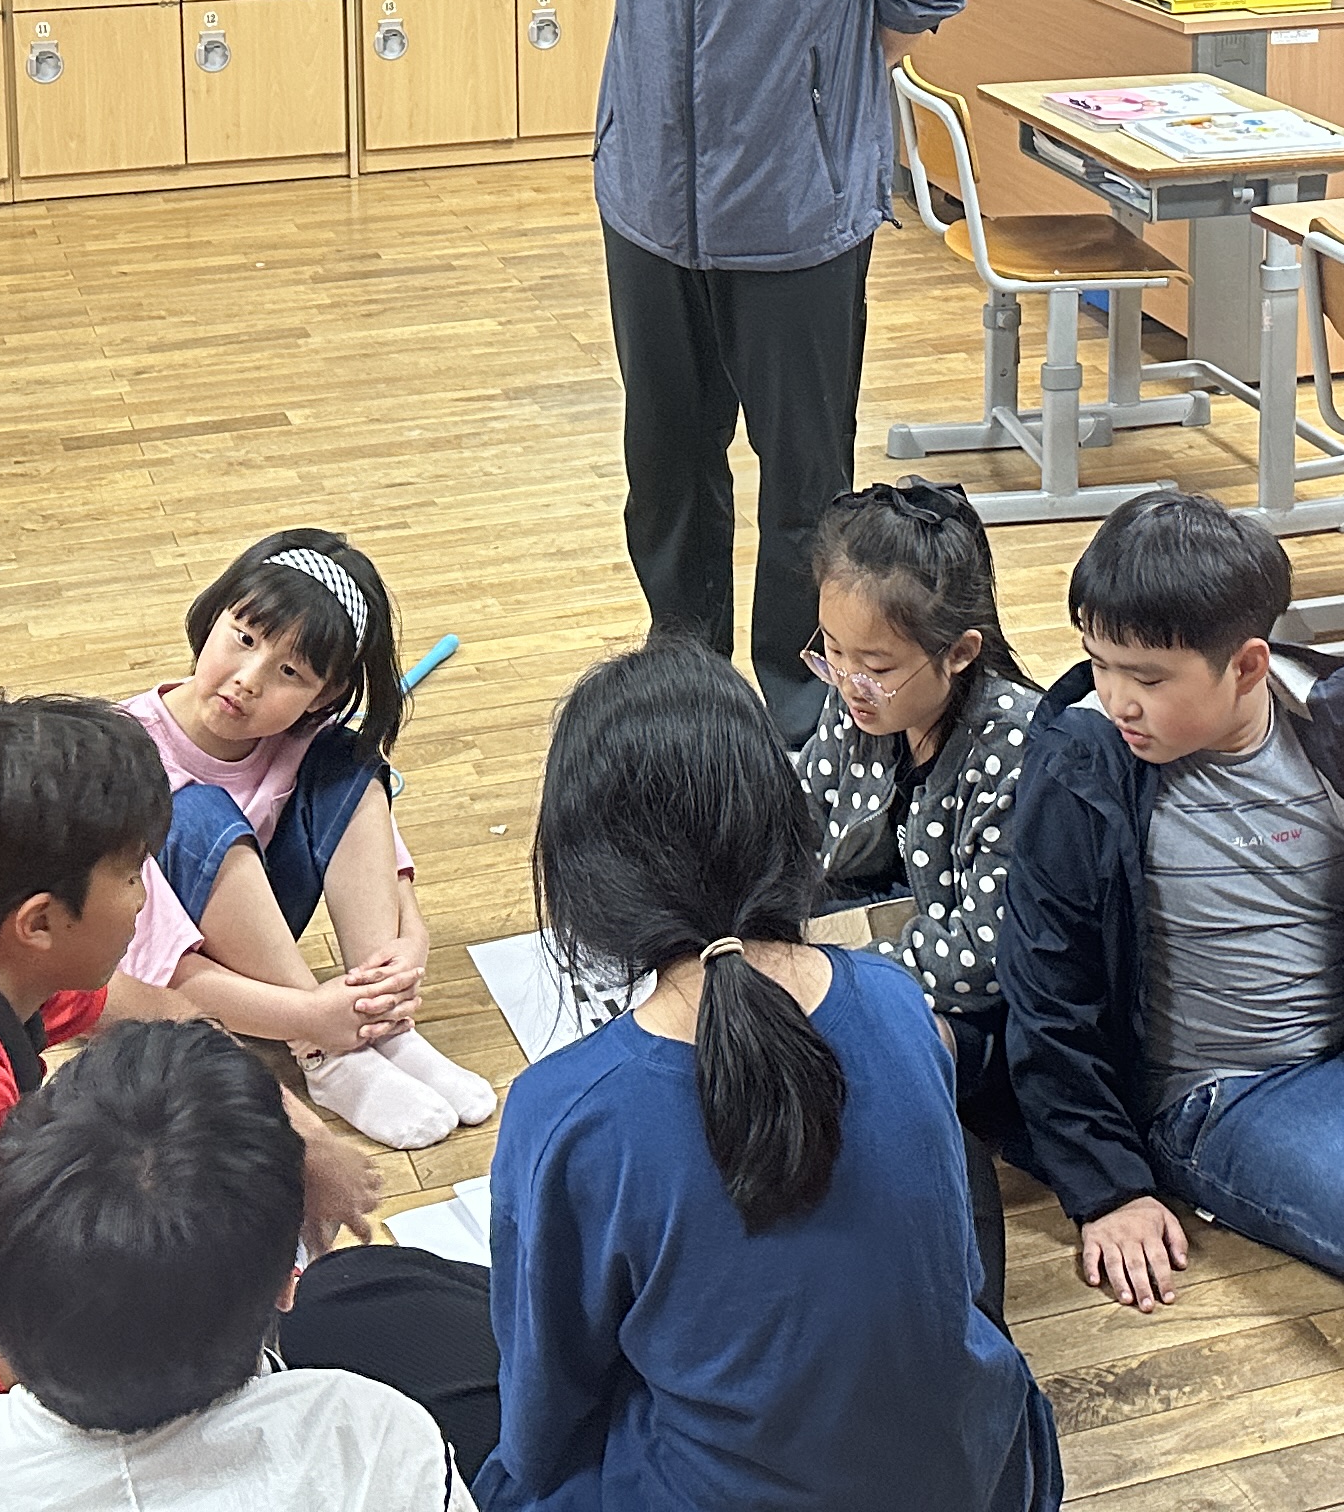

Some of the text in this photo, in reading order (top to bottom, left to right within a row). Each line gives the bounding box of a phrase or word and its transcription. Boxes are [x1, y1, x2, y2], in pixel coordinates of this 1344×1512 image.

[386, 2, 395, 12] 13
[206, 14, 216, 24] 12
[38, 24, 48, 35] 11
[1271, 827, 1303, 843] NOW
